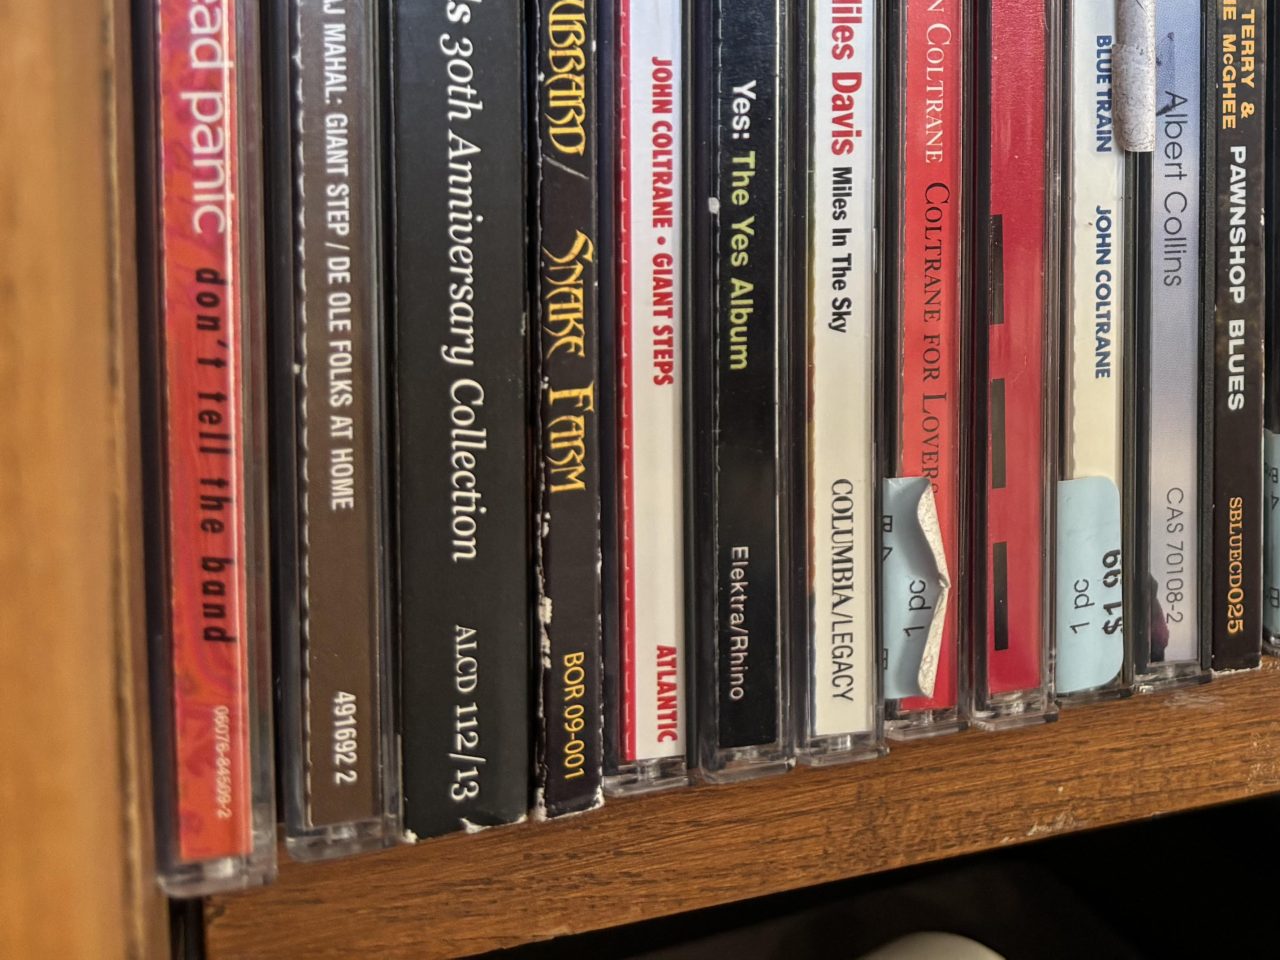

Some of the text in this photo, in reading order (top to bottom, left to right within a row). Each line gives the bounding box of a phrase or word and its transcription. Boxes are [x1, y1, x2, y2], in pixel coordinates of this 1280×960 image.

[323, 23, 348, 106] MAHAL:
[440, 33, 482, 120] 30th
[924, 23, 954, 163] COLTRANE
[1222, 33, 1238, 130] McGHEE
[1240, 8, 1256, 89] TERRY
[324, 112, 349, 176] GIANT
[829, 71, 863, 157] Davis
[1163, 90, 1189, 181] Albert
[1241, 101, 1256, 119] &
[180, 92, 235, 234] panic
[830, 166, 853, 222] Miles
[1094, 34, 1113, 379] BLUE TRAIN JOHN COLTRANE
[325, 184, 351, 236] STEP
[441, 130, 482, 366] Anniversary
[650, 56, 676, 387] JOHN COLTRANE GIANT STEPS
[728, 79, 757, 371] Yes: The Yes Album
[831, 227, 852, 247] In
[922, 181, 951, 323] COLTRANE
[1163, 190, 1188, 287] Collins
[327, 257, 353, 285] DE
[328, 292, 353, 332] OLE
[544, 230, 594, 359] SNAKE
[828, 296, 852, 334] Sky
[831, 253, 852, 291] The
[1227, 145, 1246, 411] PAWNSHOP BLUES
[196, 267, 228, 368] don't
[921, 333, 943, 383] FOR
[329, 341, 354, 408] FOLKS
[198, 392, 231, 455] tell
[330, 416, 354, 440] AT
[547, 381, 596, 494] FARM
[200, 478, 233, 533] the
[330, 450, 355, 510] HOME
[448, 378, 487, 563] Collection
[202, 556, 236, 644] band
[830, 478, 855, 702] COLUMBIA/LEGACY
[1164, 486, 1185, 625] CAS 70108-2
[1225, 496, 1245, 634] SBLUECD025
[728, 545, 749, 701] Elektra/Rhino
[902, 579, 932, 637] 1 pc
[1069, 579, 1091, 635] 1 pc
[332, 691, 357, 784] 491692 2
[449, 625, 485, 802] ALCD 112/13
[563, 650, 586, 780] BOR 09-001
[655, 644, 680, 744] ATLANTIC
